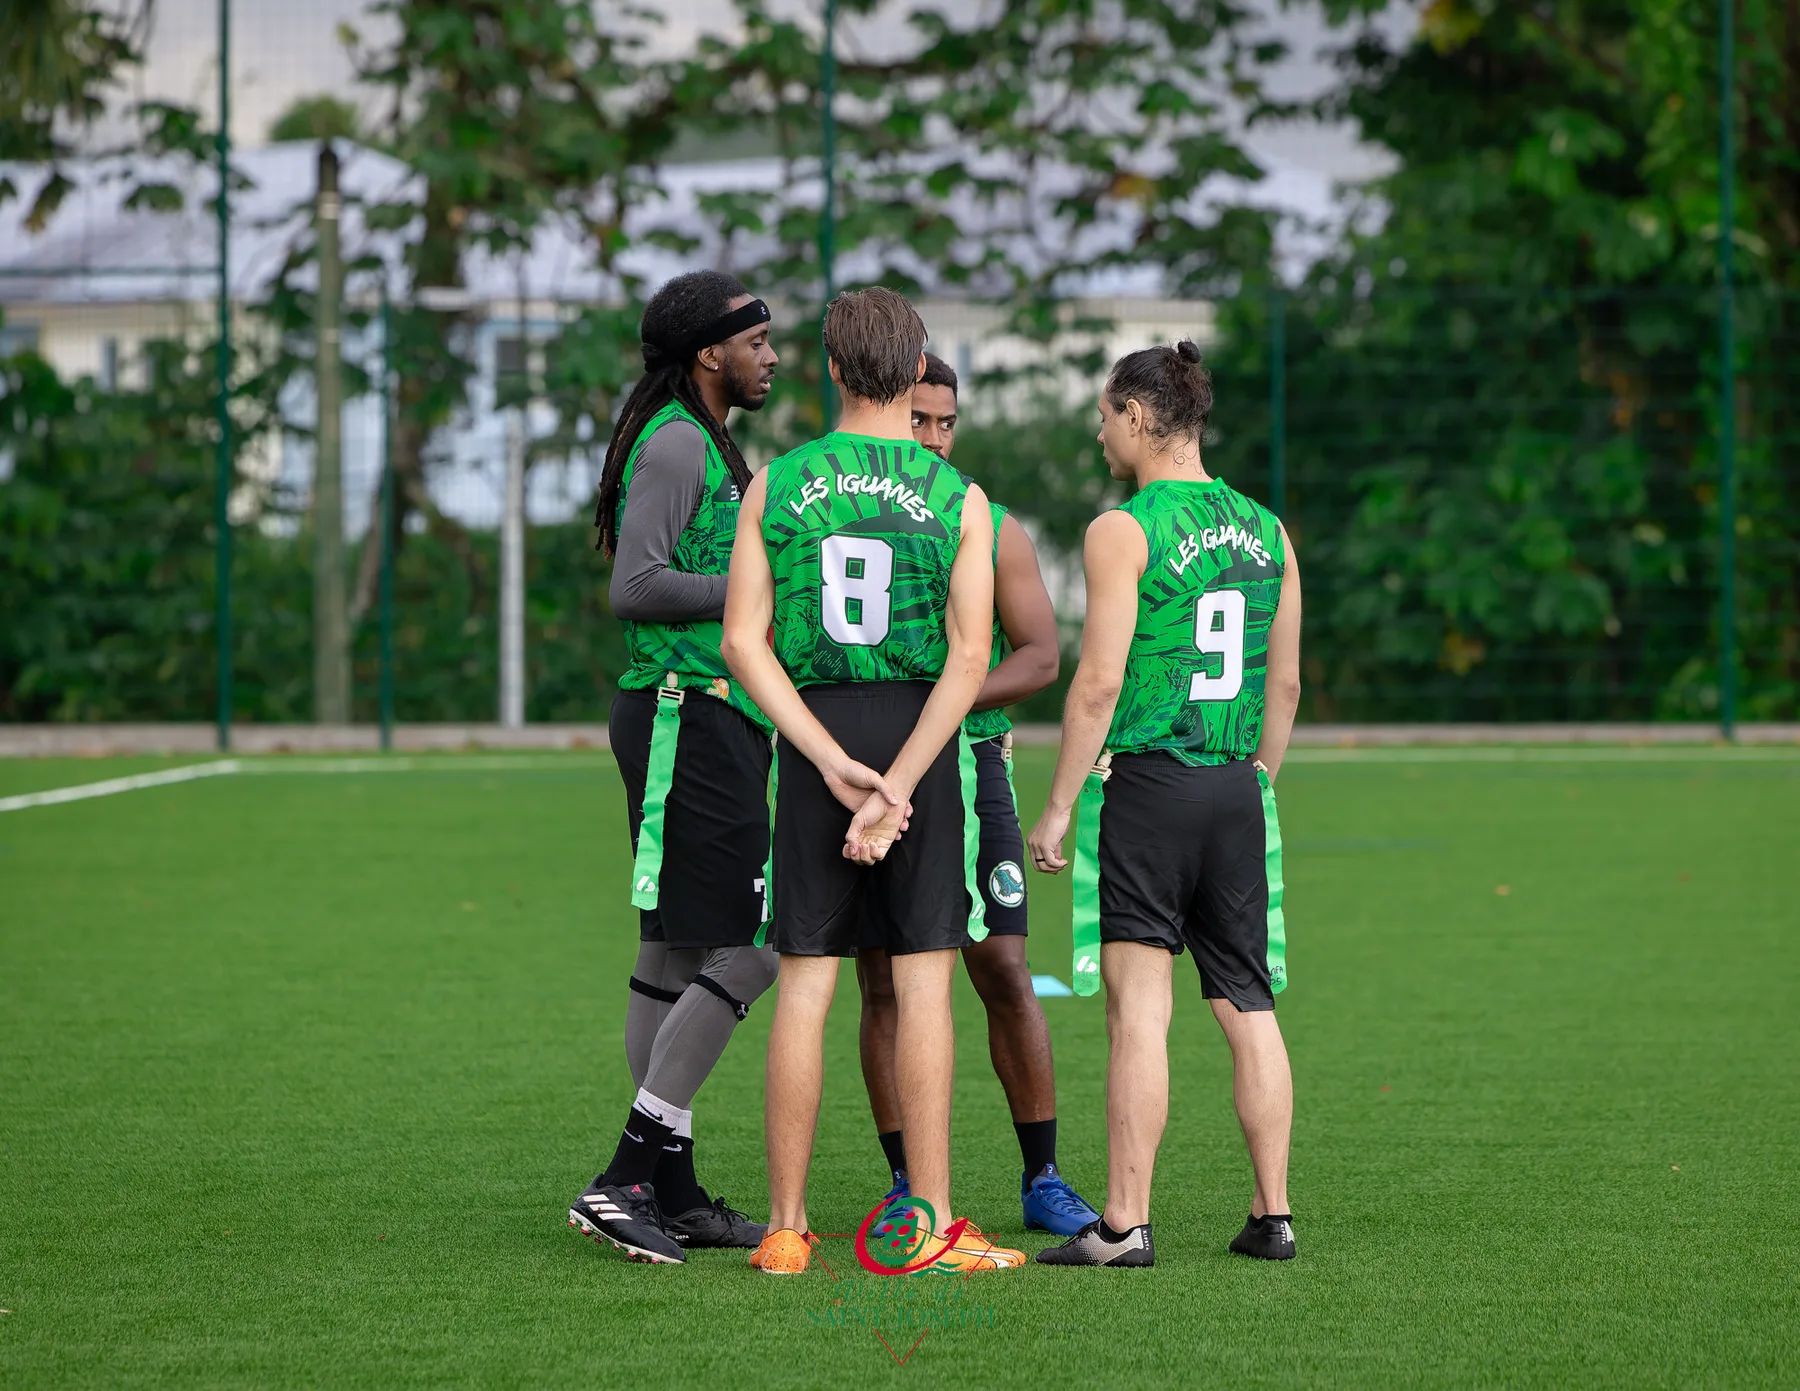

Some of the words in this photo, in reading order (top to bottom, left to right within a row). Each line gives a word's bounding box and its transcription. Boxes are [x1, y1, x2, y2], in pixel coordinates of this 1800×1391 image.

[789, 476, 829, 515] LES
[836, 474, 934, 522] IGUANES
[821, 535, 893, 646] 8
[1169, 534, 1199, 575] LES
[1188, 590, 1246, 701] 9
